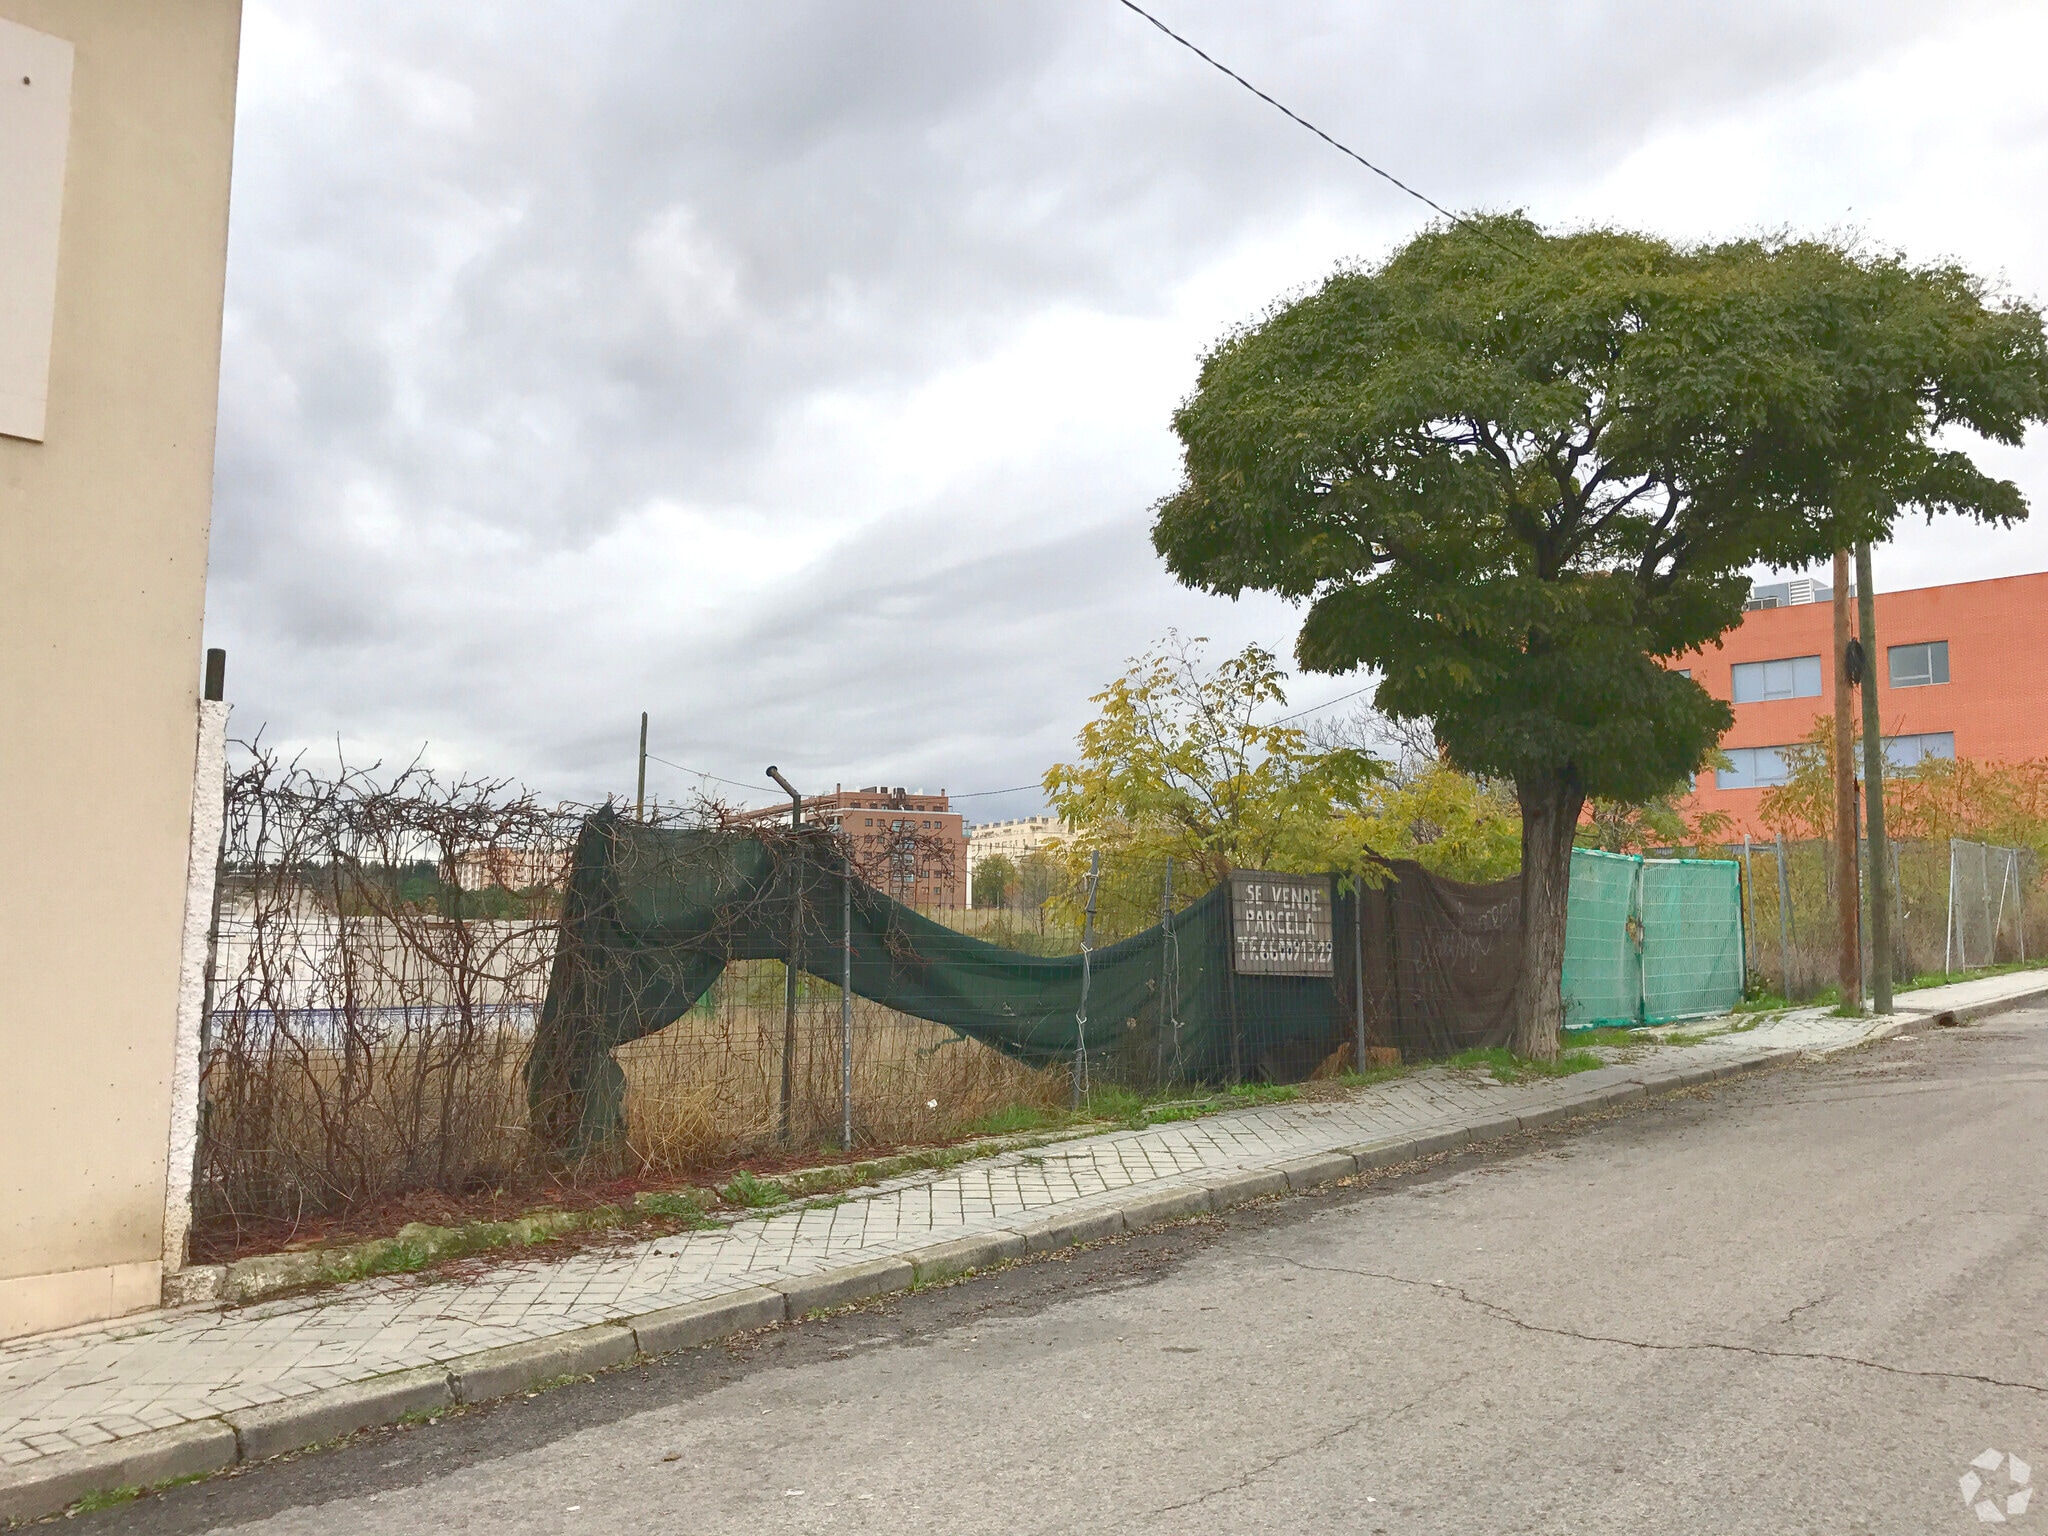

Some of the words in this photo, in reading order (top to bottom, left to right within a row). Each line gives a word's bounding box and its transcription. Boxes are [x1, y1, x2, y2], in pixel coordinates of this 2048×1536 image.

[1245, 884, 1263, 904] SE
[1272, 886, 1321, 911] VENDE
[1246, 909, 1315, 935] PARCELA
